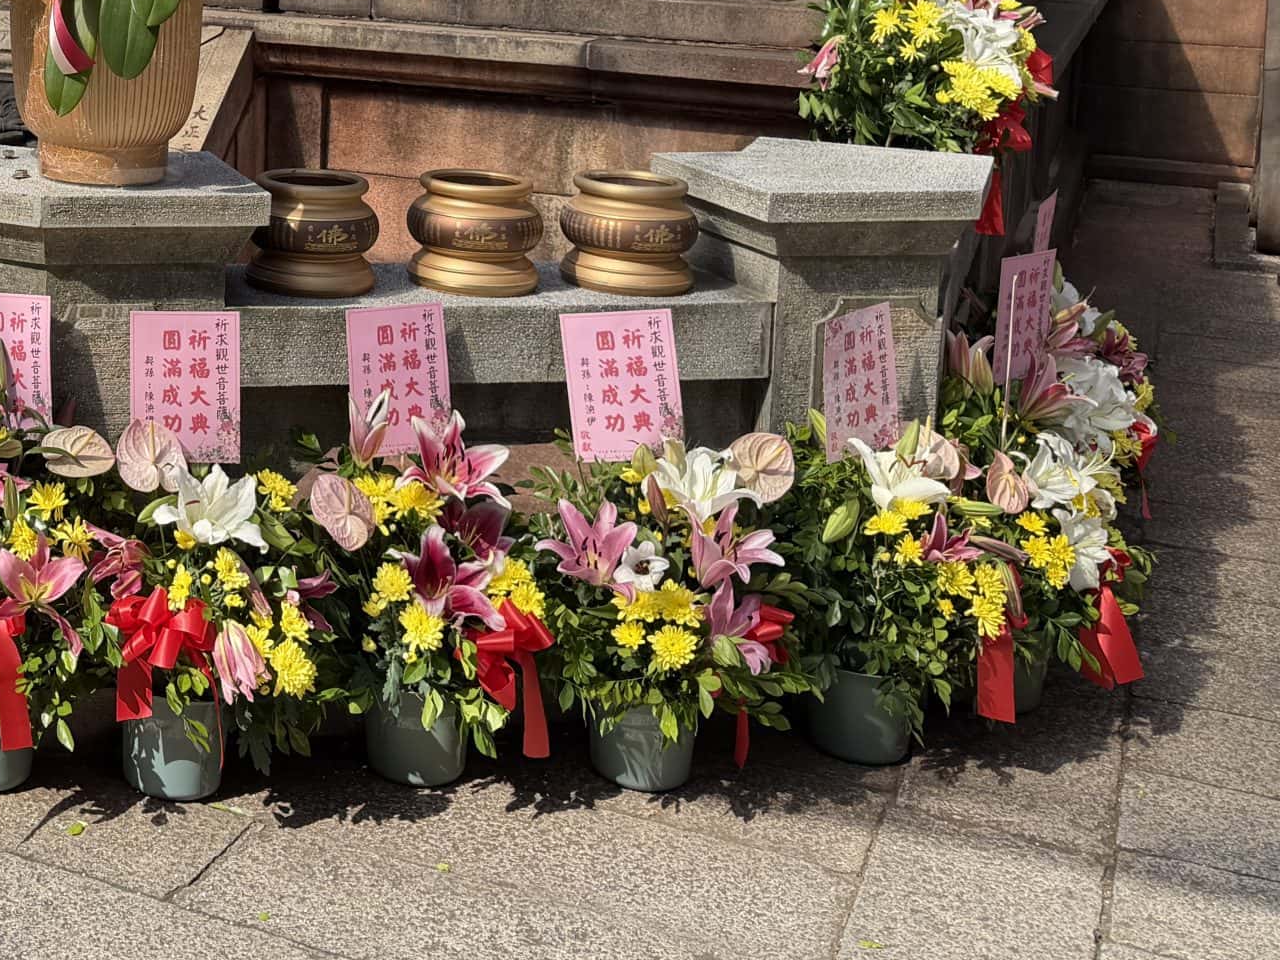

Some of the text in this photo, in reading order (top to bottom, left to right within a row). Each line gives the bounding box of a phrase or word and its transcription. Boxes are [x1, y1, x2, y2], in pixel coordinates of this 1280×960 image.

[316, 224, 349, 246] 佛
[464, 223, 498, 244] 佛
[644, 224, 676, 245] 佛
[161, 330, 183, 433] 圓滿成功
[188, 329, 211, 435] 祈福大典
[595, 330, 625, 433] 圓滿成功
[622, 328, 655, 432] 祈福大典
[843, 330, 860, 428] 圓滿成功
[858, 324, 878, 424] 祈福大典
